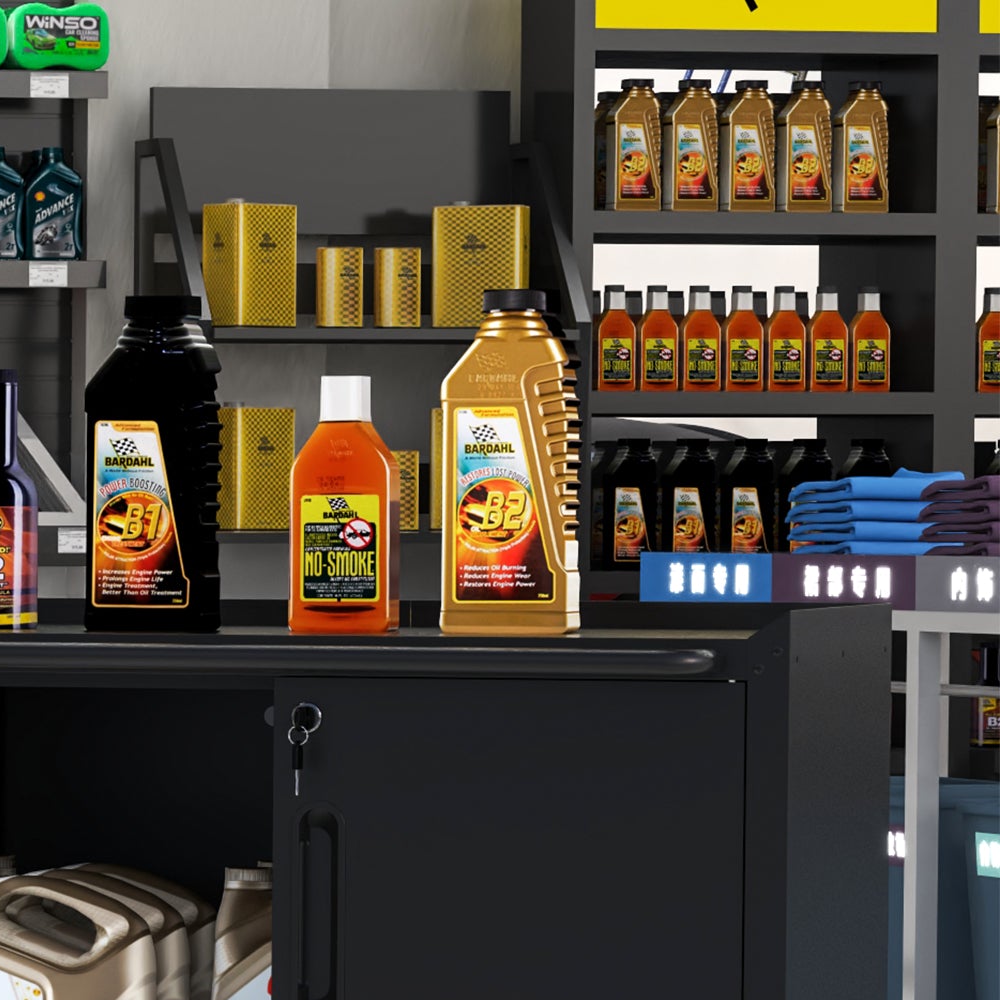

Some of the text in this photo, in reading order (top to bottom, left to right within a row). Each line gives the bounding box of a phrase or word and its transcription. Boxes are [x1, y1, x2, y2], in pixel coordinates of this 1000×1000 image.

[34, 193, 74, 224] ADVANCE
[464, 443, 516, 456] BARDAHL
[104, 456, 155, 470] BARDAHL
[99, 477, 167, 498] POWER BOOSTING
[460, 467, 530, 488] RESTORES LOST POWER
[121, 503, 163, 541] B1
[480, 490, 526, 530] B2
[304, 550, 375, 577] NO-SMOKE
